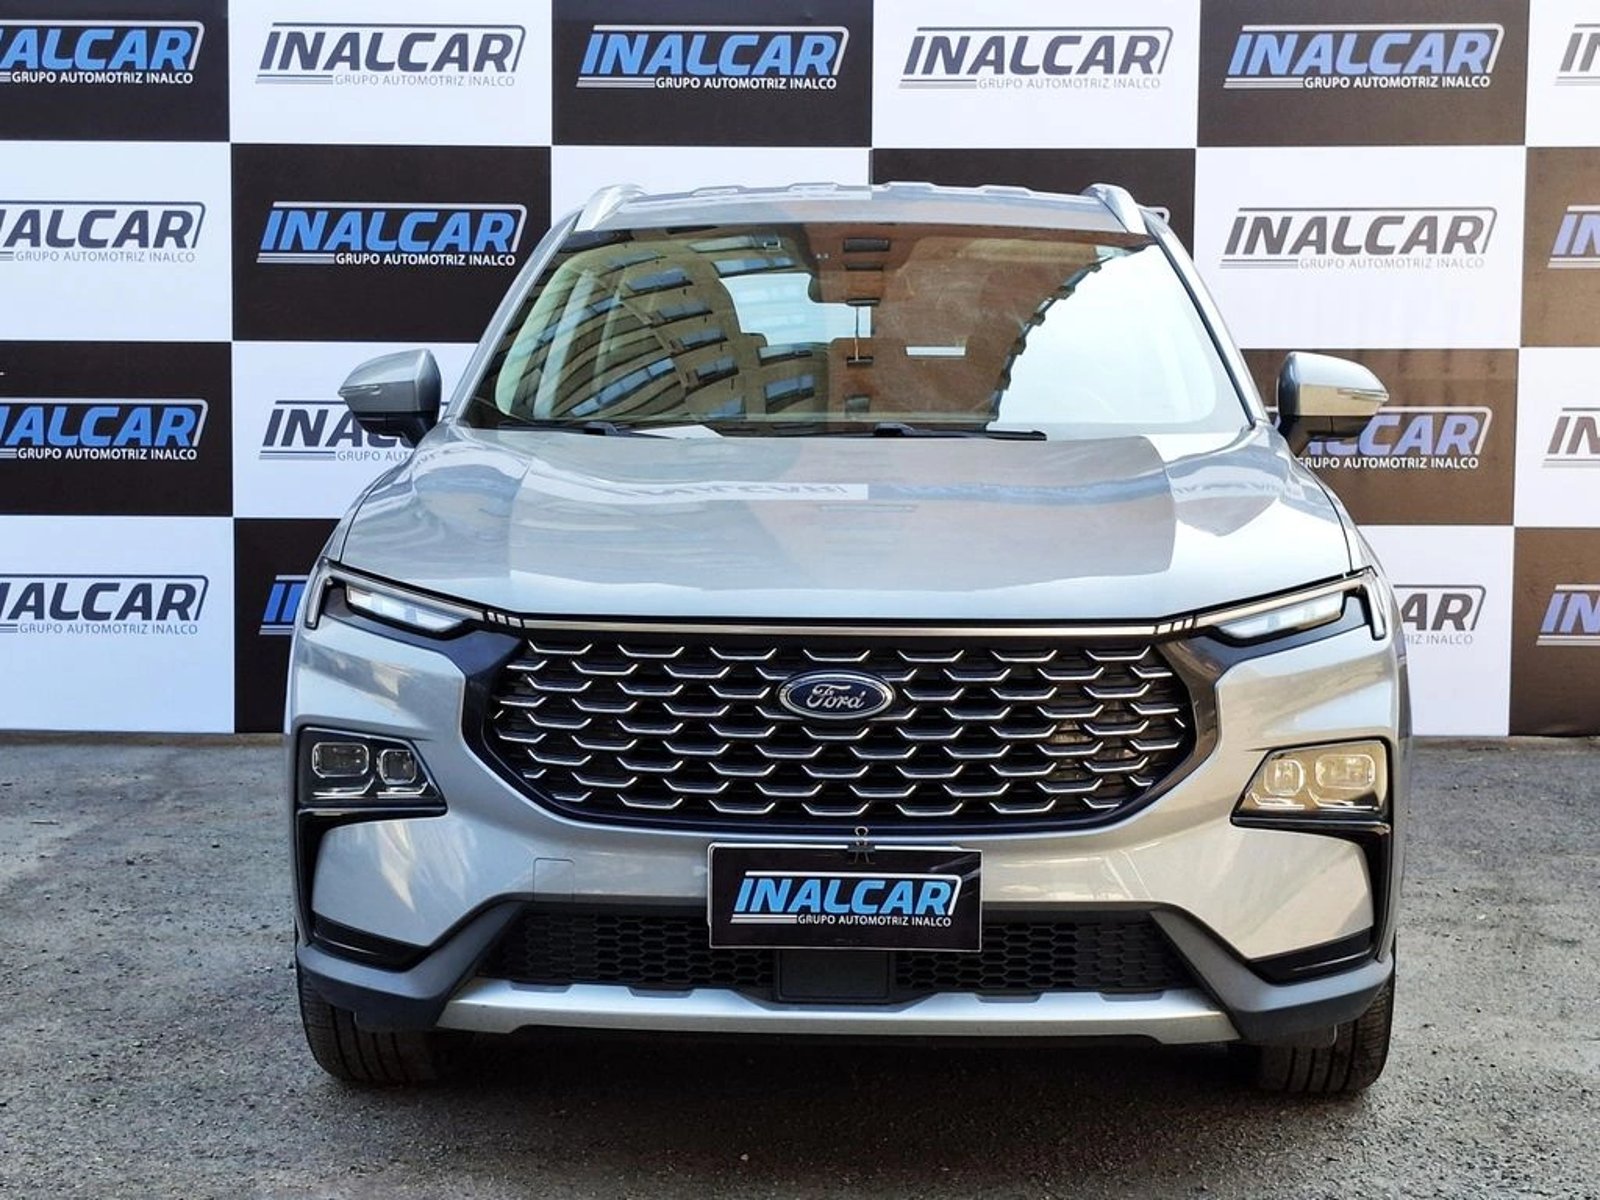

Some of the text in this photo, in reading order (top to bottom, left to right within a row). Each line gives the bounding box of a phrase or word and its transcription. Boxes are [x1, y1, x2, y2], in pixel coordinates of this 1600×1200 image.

[0, 28, 194, 70] ALCAR
[260, 31, 514, 72] INALCAR
[581, 33, 838, 76] INALCAR
[904, 35, 1159, 75] INALCAR
[1227, 33, 1492, 76] INALCAR
[11, 72, 193, 84] GRUPO AUTOMOTRIZ INALCO
[335, 74, 515, 87] GRUPO AUTOMOTRIZ INALCO
[656, 77, 837, 90] GRUPO AUTOMOTRIZ INALCO
[978, 78, 1160, 89] GRUPO AUTOMOTRIZ INALCO
[1304, 76, 1490, 89] GRUPO AUTOMOTRIZ INALCO
[0, 209, 195, 249] ALCAR
[261, 210, 515, 252] INALCAR
[1224, 216, 1484, 255] INALCAR
[15, 250, 195, 263] GRUPO AUTOMOTRIZ INALCO
[336, 253, 515, 266] GRUPO AUTOMOTRIZ INALCO
[1349, 258, 1433, 269] AUTOMOTRIZ
[1437, 258, 1484, 269] INALCO
[0, 406, 196, 446] ALCAR
[262, 409, 415, 449] INA
[18, 447, 197, 460] GRUPO AUTOMOTRIZ INALCO
[337, 452, 380, 461] GRUPO
[1344, 457, 1427, 468] AUTOMOTRIZ
[1431, 457, 1479, 468] INALCO
[0, 582, 196, 621] ALCAR
[20, 623, 198, 634] GRUPO AUTOMOTRIZ INALCO
[1426, 634, 1473, 645] INALCO
[806, 683, 866, 709] Ford
[734, 878, 950, 914] INALCAR
[798, 914, 952, 927] GRUPO AUTOMOTRIZ INALCO
